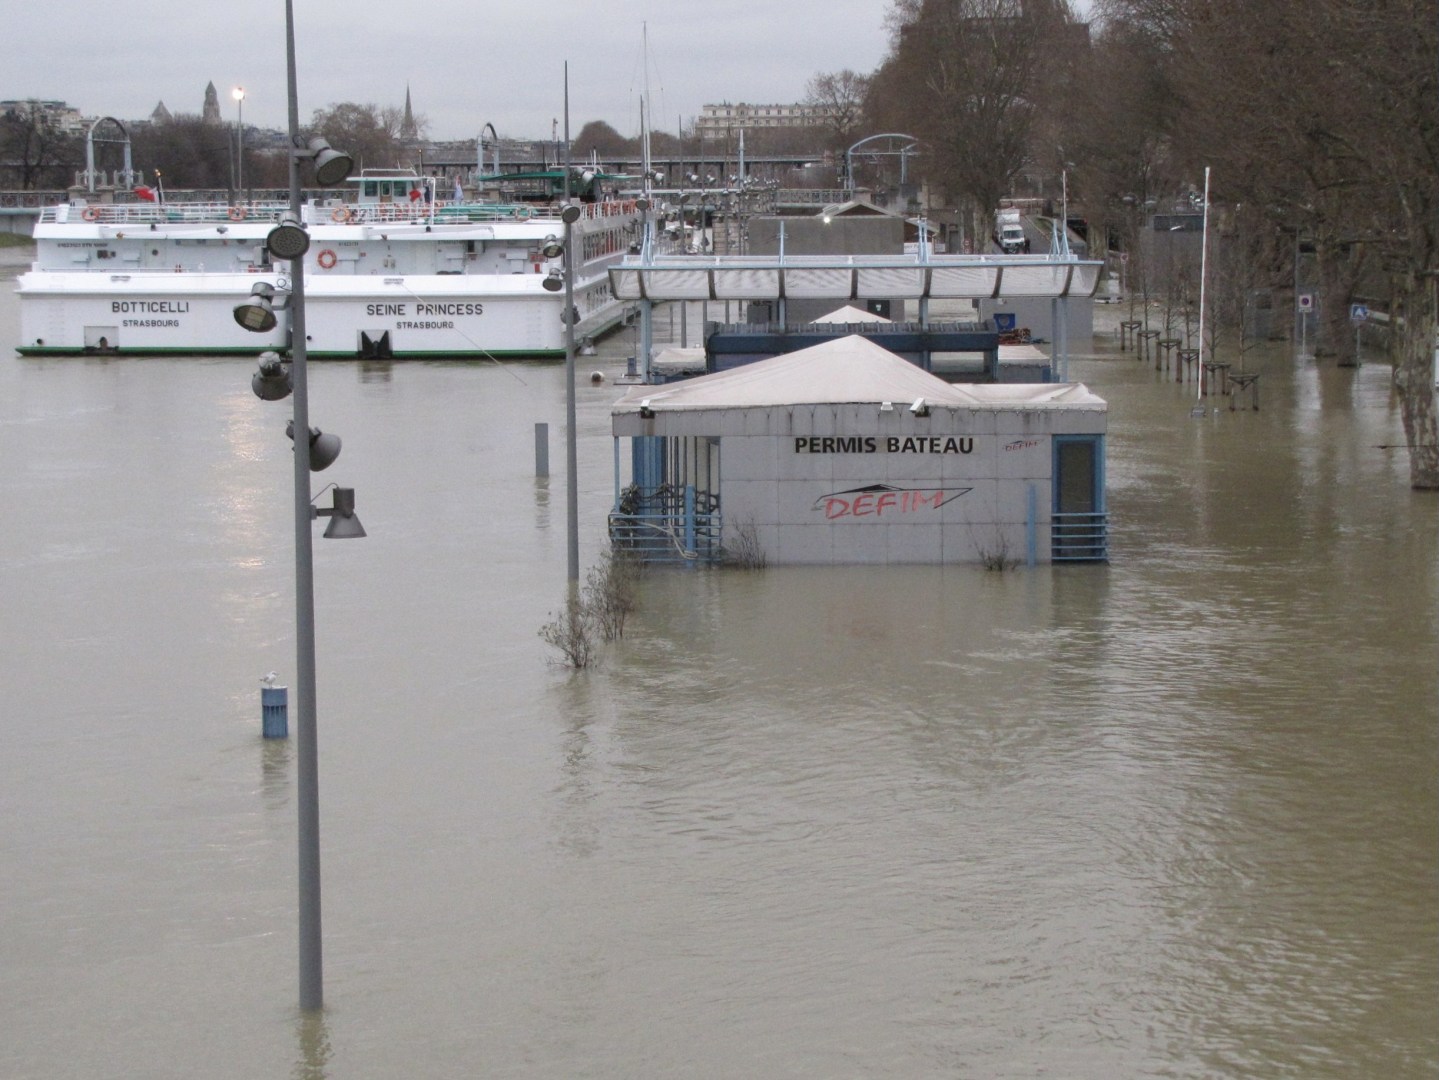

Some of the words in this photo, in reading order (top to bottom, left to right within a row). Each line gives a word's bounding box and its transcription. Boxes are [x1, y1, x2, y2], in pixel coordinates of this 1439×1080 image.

[112, 301, 189, 313] BOTTICELLI
[366, 304, 406, 316] SEINE
[416, 304, 484, 316] PRINCESS
[122, 319, 180, 328] STRASBOURG
[396, 321, 455, 330] STRASBOURG
[794, 436, 877, 454] PERMIS
[886, 436, 974, 455] BATEAU
[823, 488, 945, 520] DEFIM
